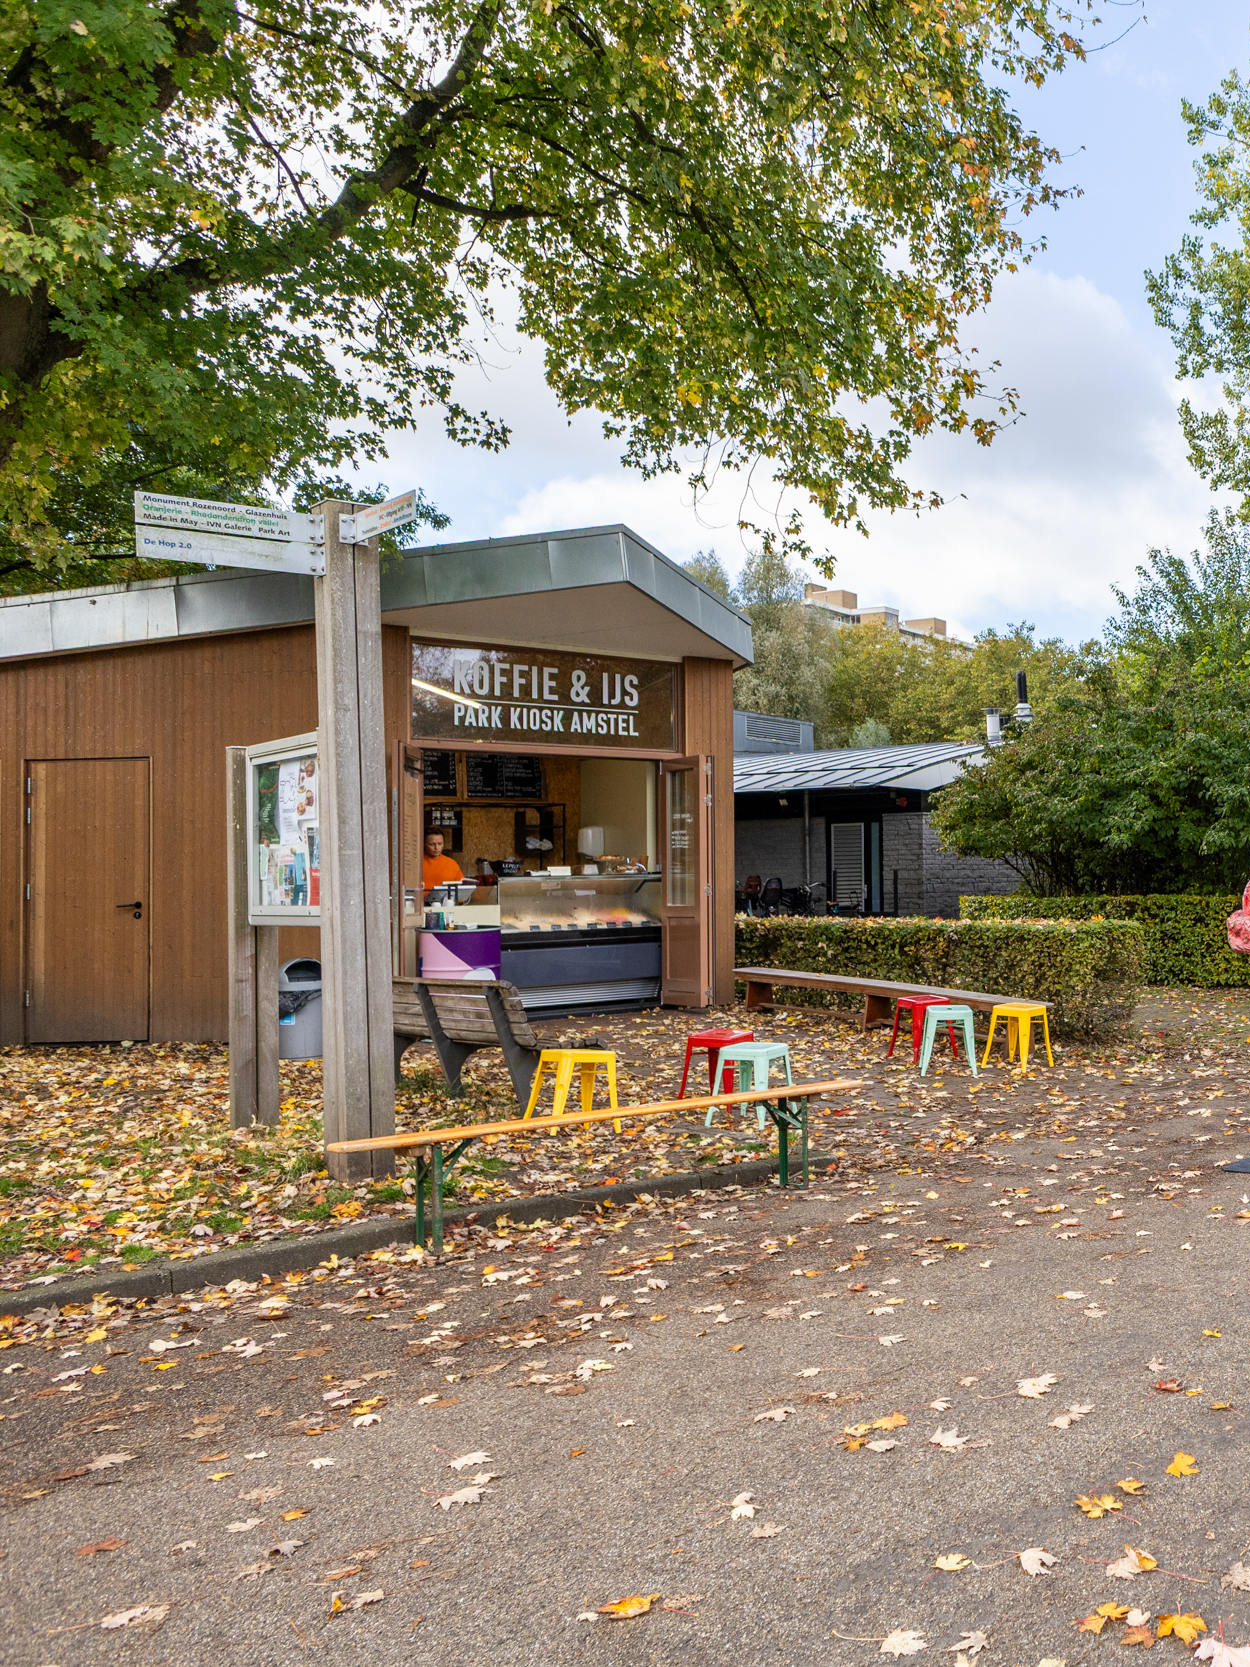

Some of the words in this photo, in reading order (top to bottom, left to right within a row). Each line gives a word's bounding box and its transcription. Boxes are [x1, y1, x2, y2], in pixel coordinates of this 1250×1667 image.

[142, 504, 183, 514] Oranjerie
[258, 519, 279, 527] vallei
[143, 495, 190, 507] Monument
[192, 501, 236, 513] Rozenoord
[245, 509, 288, 520] Glazenhuis
[143, 513, 167, 521] Made
[169, 515, 178, 523] in
[180, 517, 198, 526] May
[224, 523, 252, 532] Galerie
[258, 527, 276, 535] Park
[278, 529, 291, 537] Art
[158, 539, 176, 548] Hop
[453, 659, 559, 701] KOFFIE
[570, 669, 591, 703] &
[602, 672, 639, 707] IJS
[453, 703, 503, 729] PARK
[510, 706, 564, 732] KIOSK
[570, 711, 639, 737] AMSTEL
